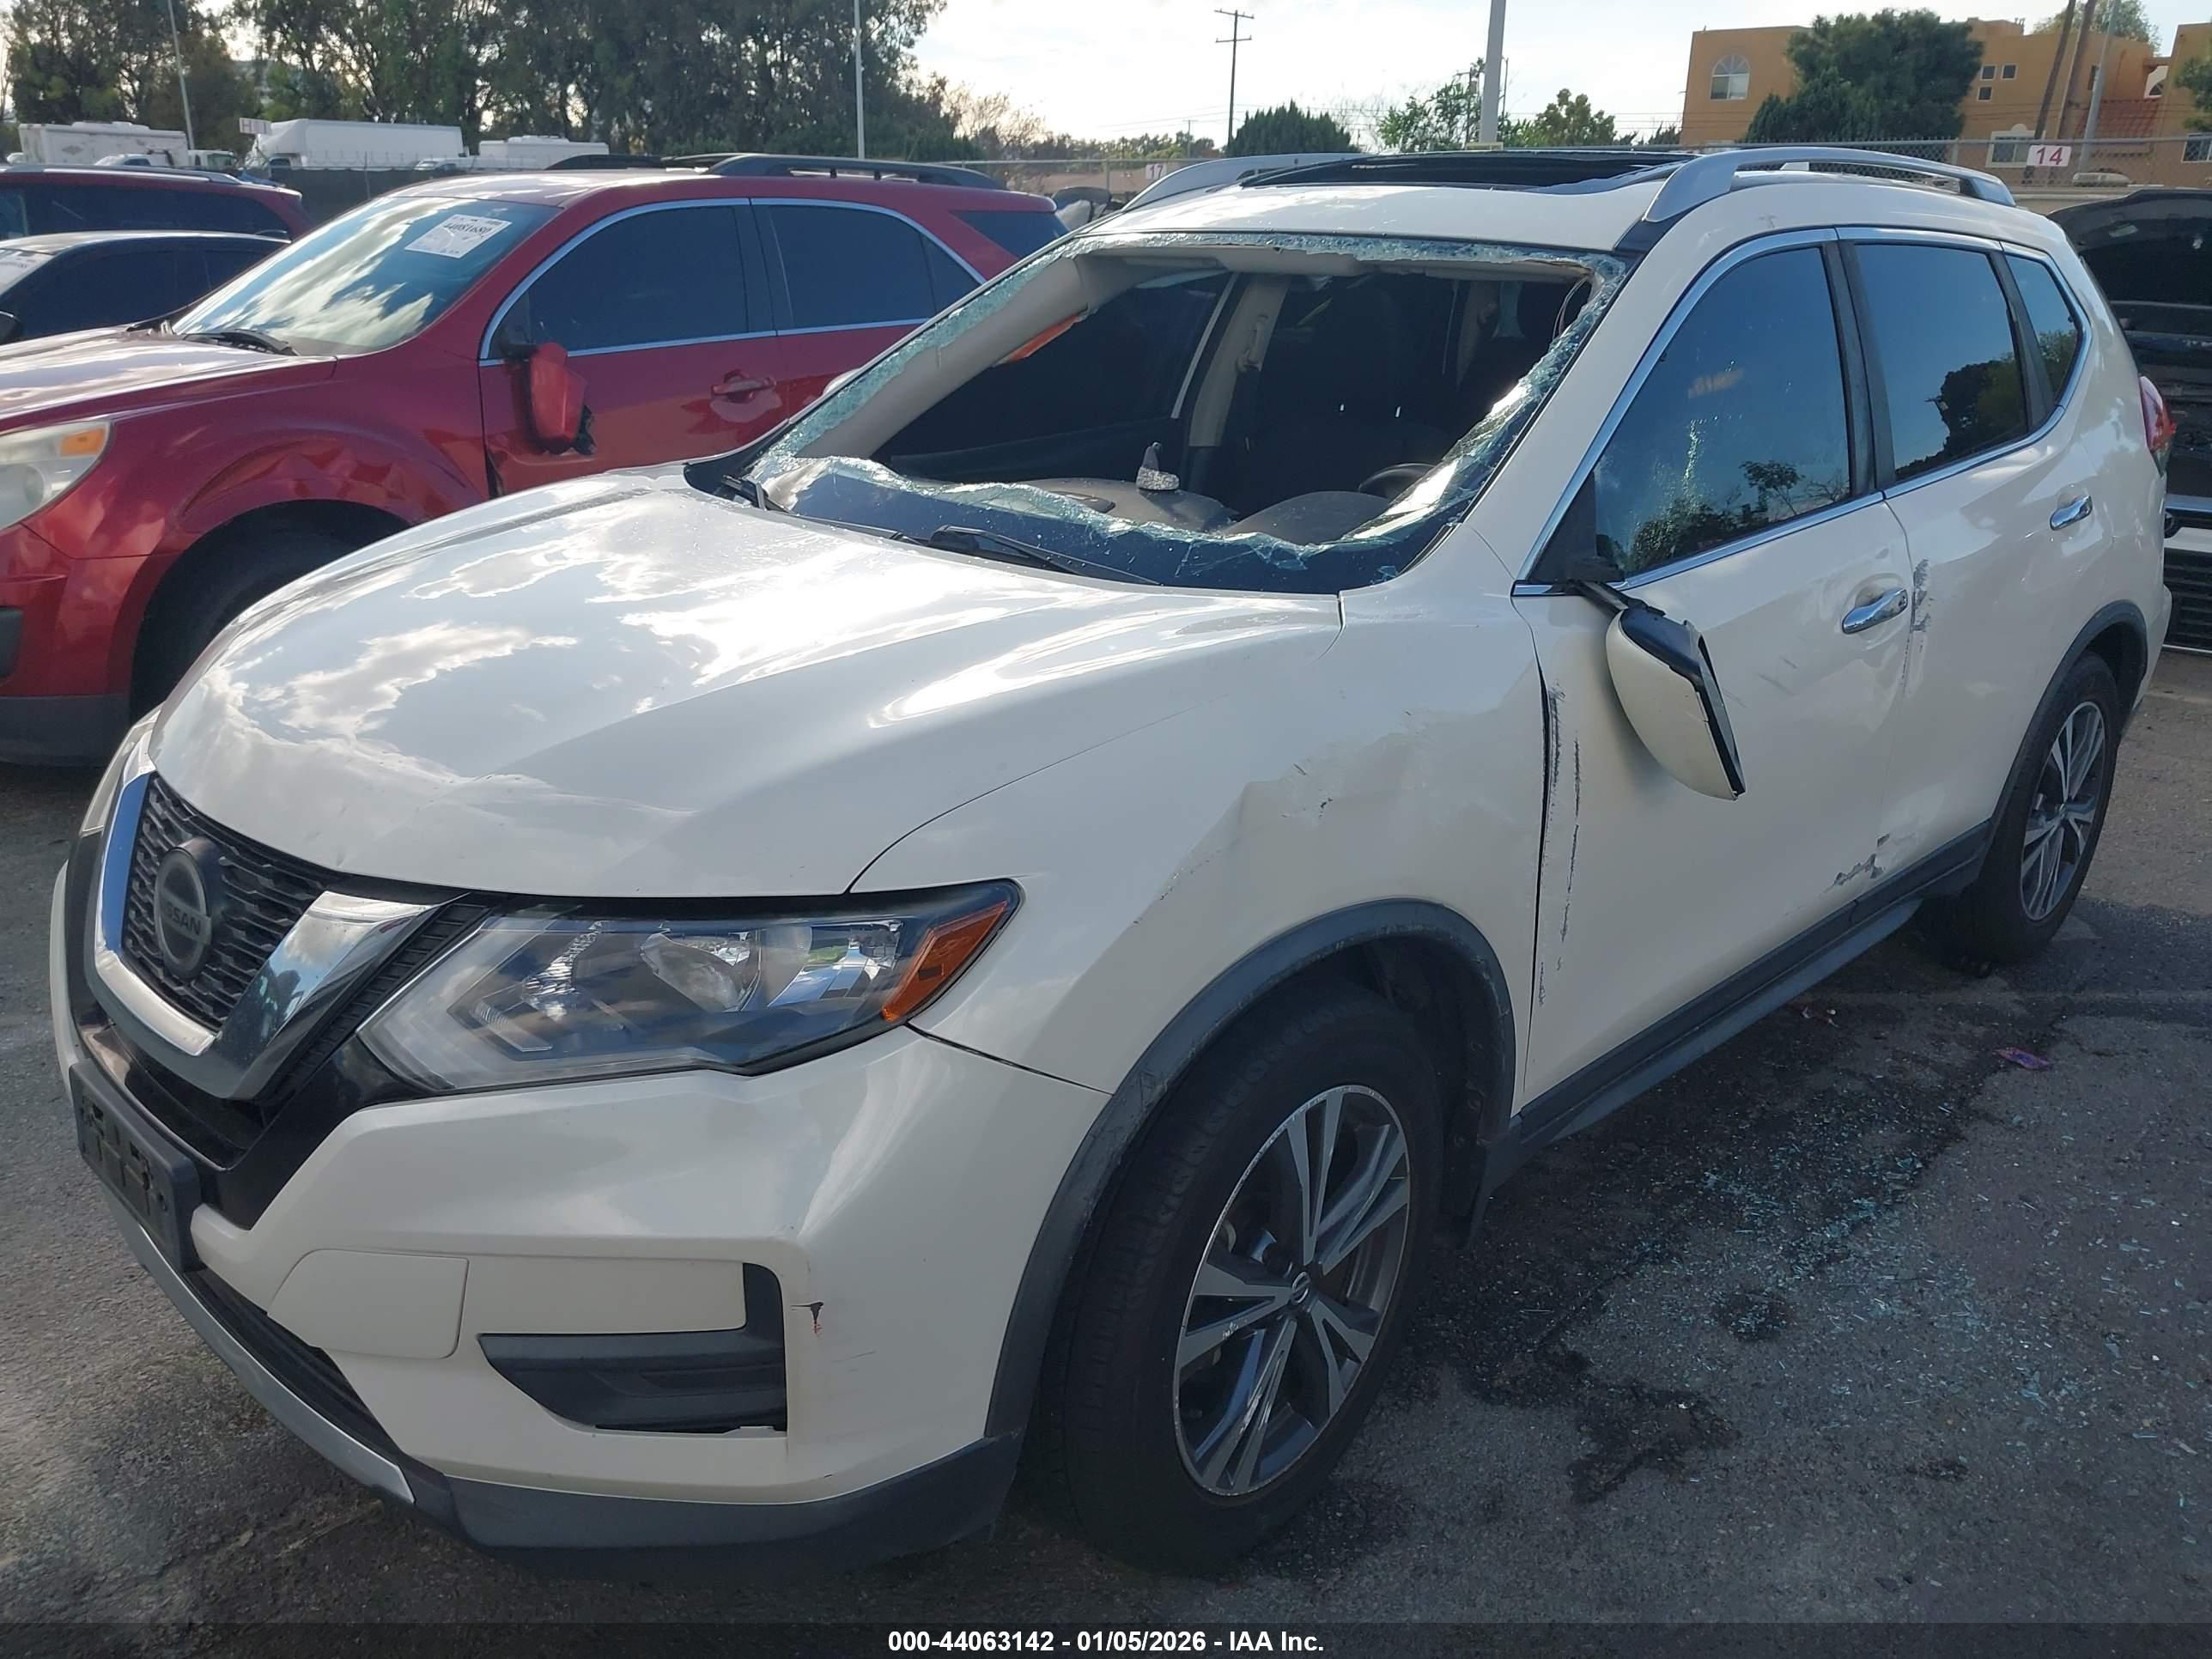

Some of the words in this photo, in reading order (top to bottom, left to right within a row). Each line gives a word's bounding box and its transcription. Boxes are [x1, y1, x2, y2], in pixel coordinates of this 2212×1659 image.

[2036, 146, 2063, 166] 14
[1150, 164, 1164, 179] 17
[160, 896, 202, 937] SSAN
